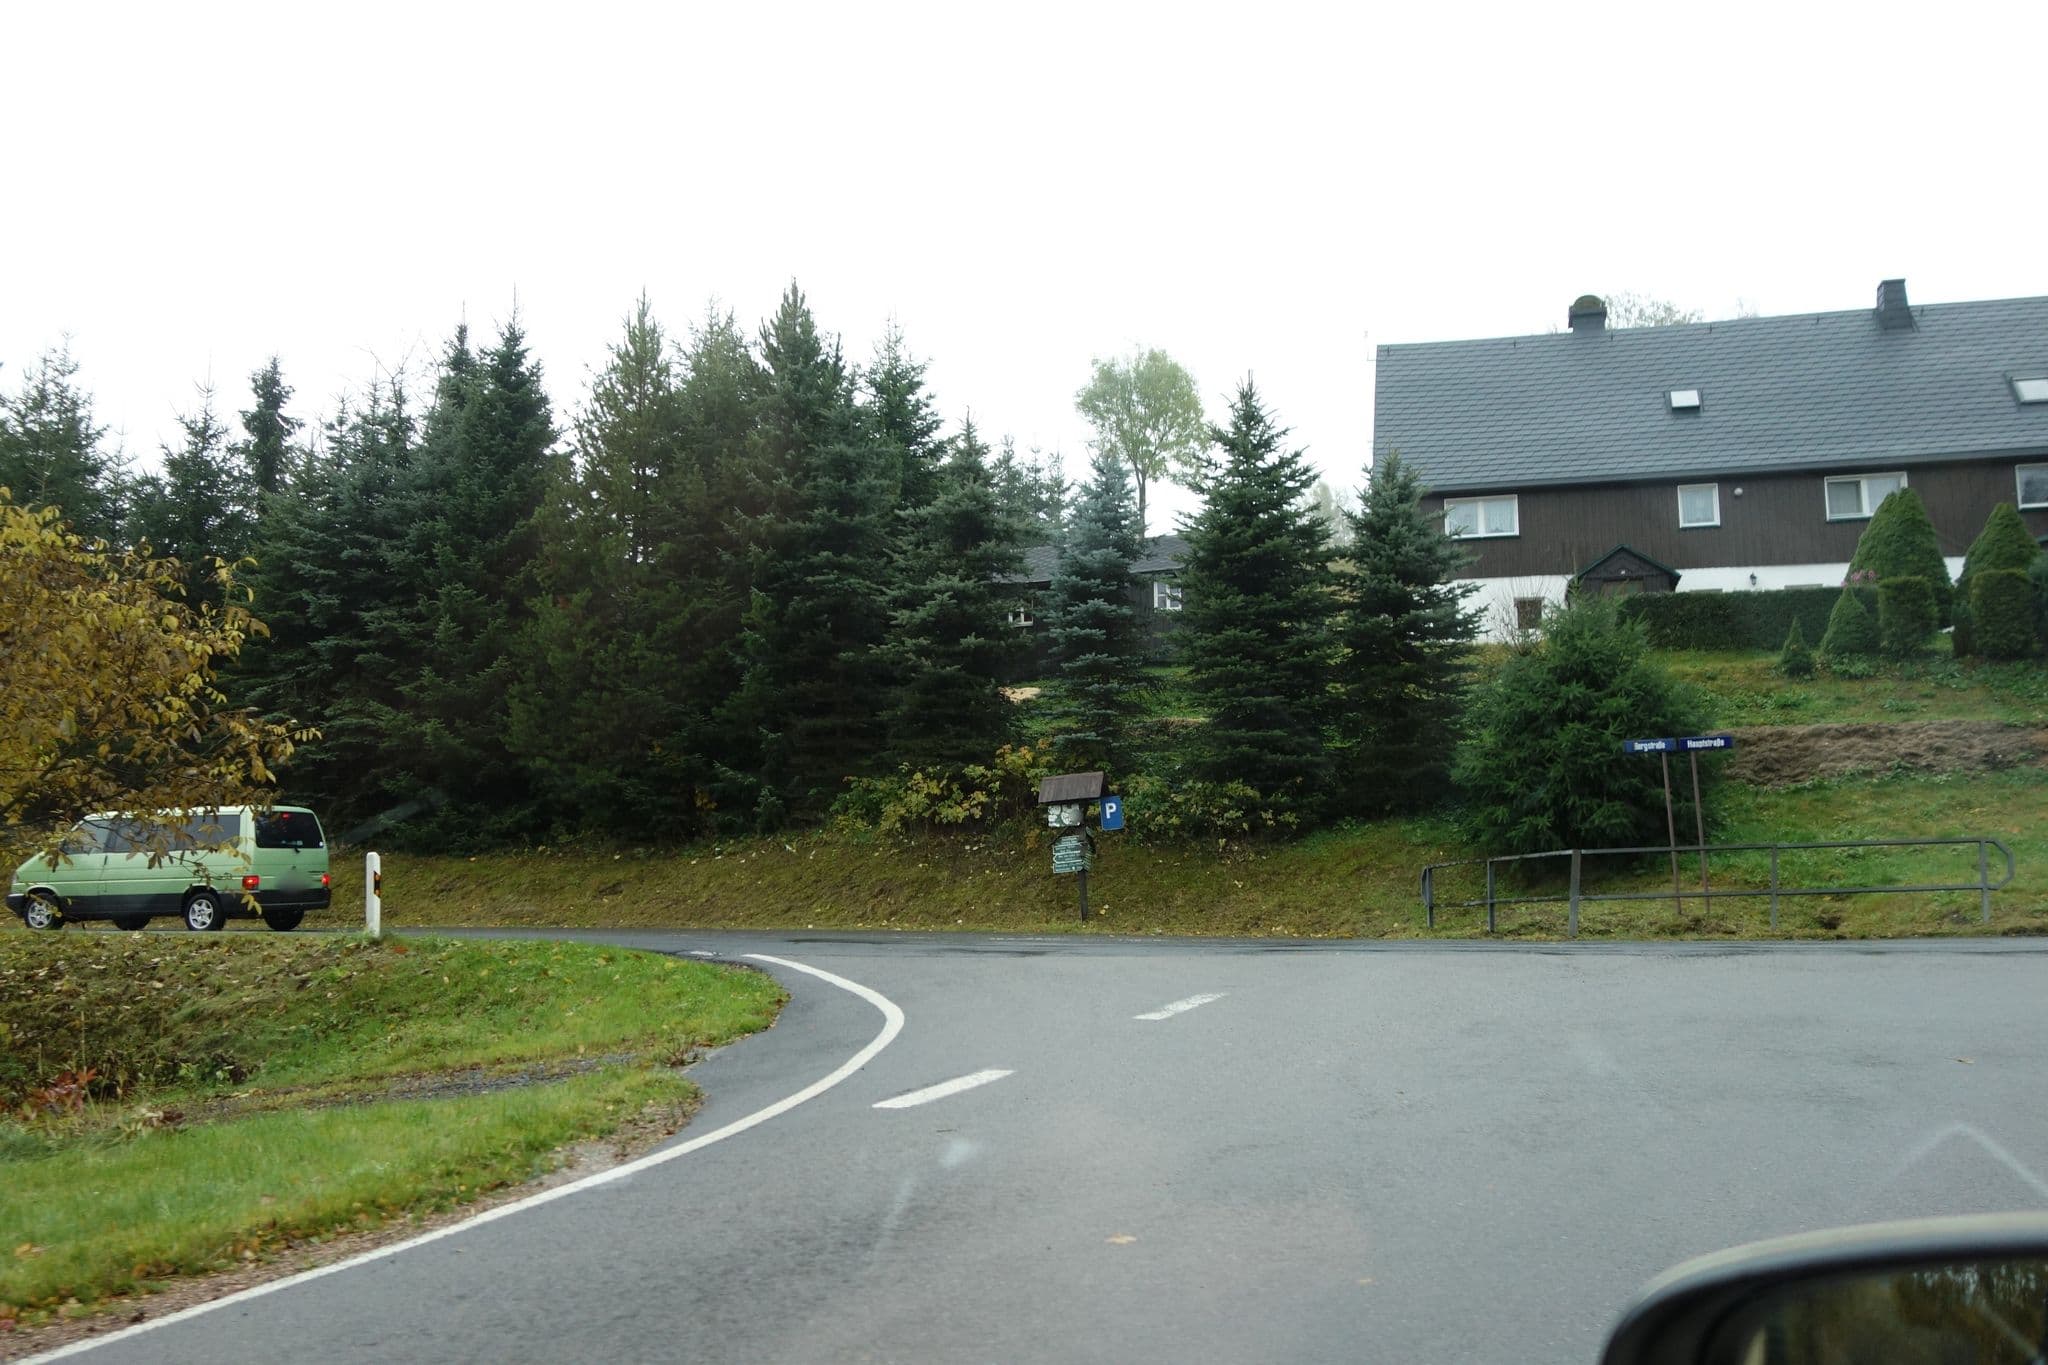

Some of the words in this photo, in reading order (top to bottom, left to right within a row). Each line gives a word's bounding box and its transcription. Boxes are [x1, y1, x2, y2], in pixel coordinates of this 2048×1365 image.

[1634, 741, 1665, 752] Bergstraße
[1687, 738, 1724, 748] Hauptstraße
[1105, 802, 1117, 819] P
